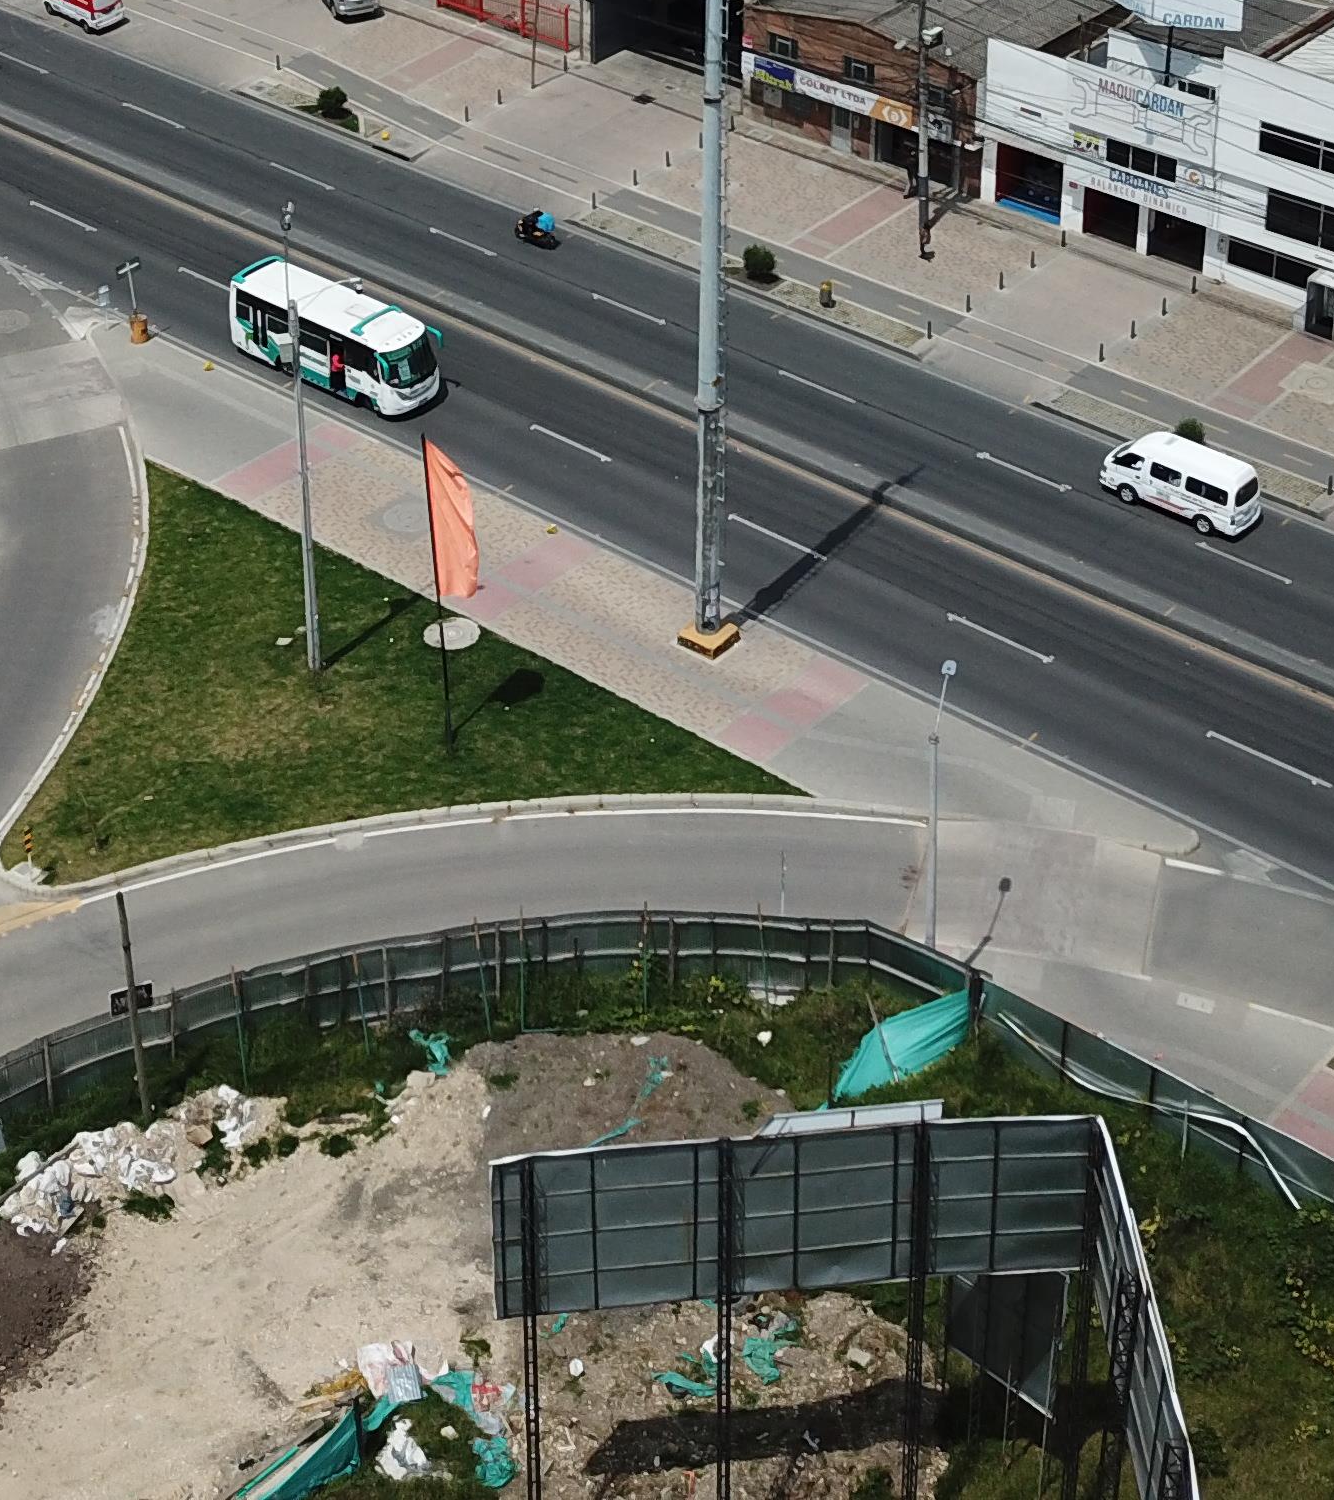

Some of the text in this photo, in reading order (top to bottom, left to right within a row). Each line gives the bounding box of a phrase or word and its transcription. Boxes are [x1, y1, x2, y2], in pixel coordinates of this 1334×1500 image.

[1162, 12, 1226, 29] CARDAN
[799, 77, 867, 106] COLRET LTDA
[1097, 77, 1185, 118] MAQUICARDAN
[1090, 176, 1188, 216] BALANCEO DINAMICO
